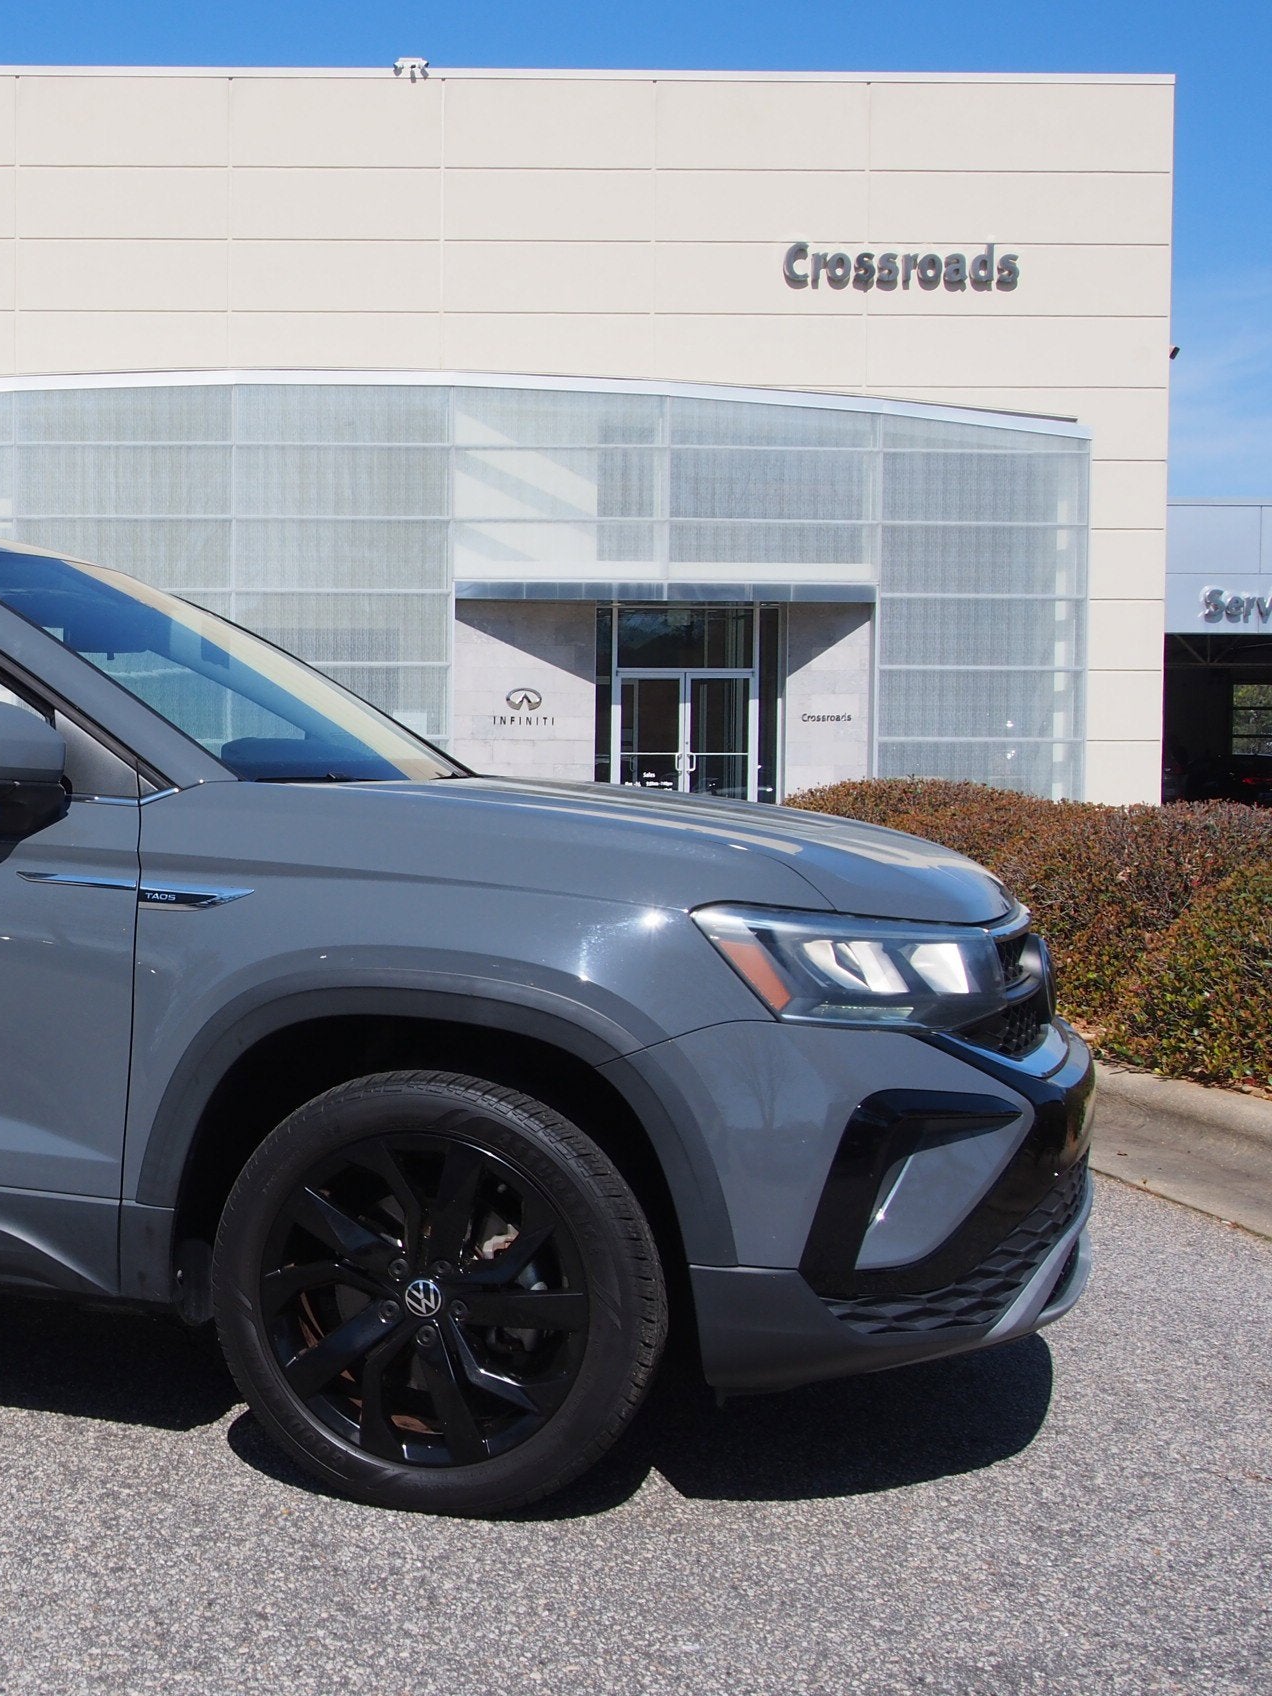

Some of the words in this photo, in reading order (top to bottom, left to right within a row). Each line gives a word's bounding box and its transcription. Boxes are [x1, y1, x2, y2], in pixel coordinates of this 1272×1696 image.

[783, 242, 1019, 284] Crossroads
[493, 716, 555, 726] INFINITI
[801, 712, 852, 722] Crossroads
[145, 892, 176, 901] TAOS
